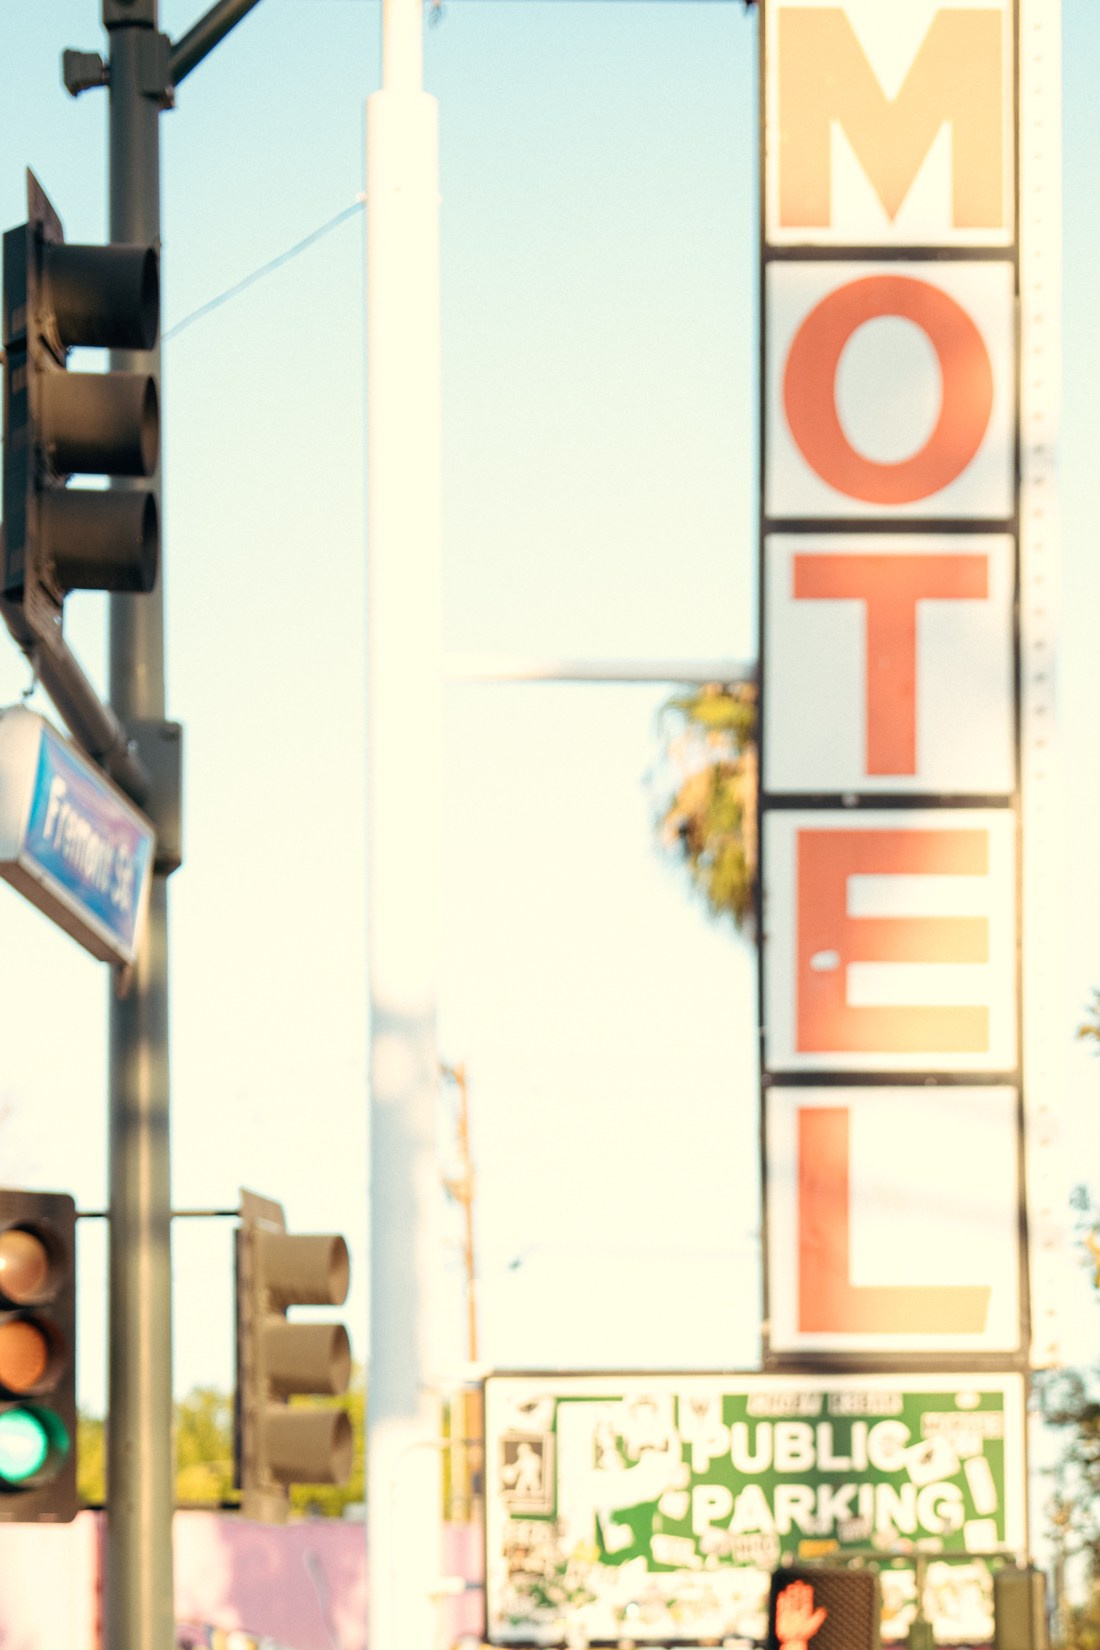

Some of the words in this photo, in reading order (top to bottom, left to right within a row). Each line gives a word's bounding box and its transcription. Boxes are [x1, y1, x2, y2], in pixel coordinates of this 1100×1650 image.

[777, 6, 1003, 1335] MOTEL
[691, 1420, 912, 1474] PUBLIC
[691, 1482, 965, 1535] PARKING
